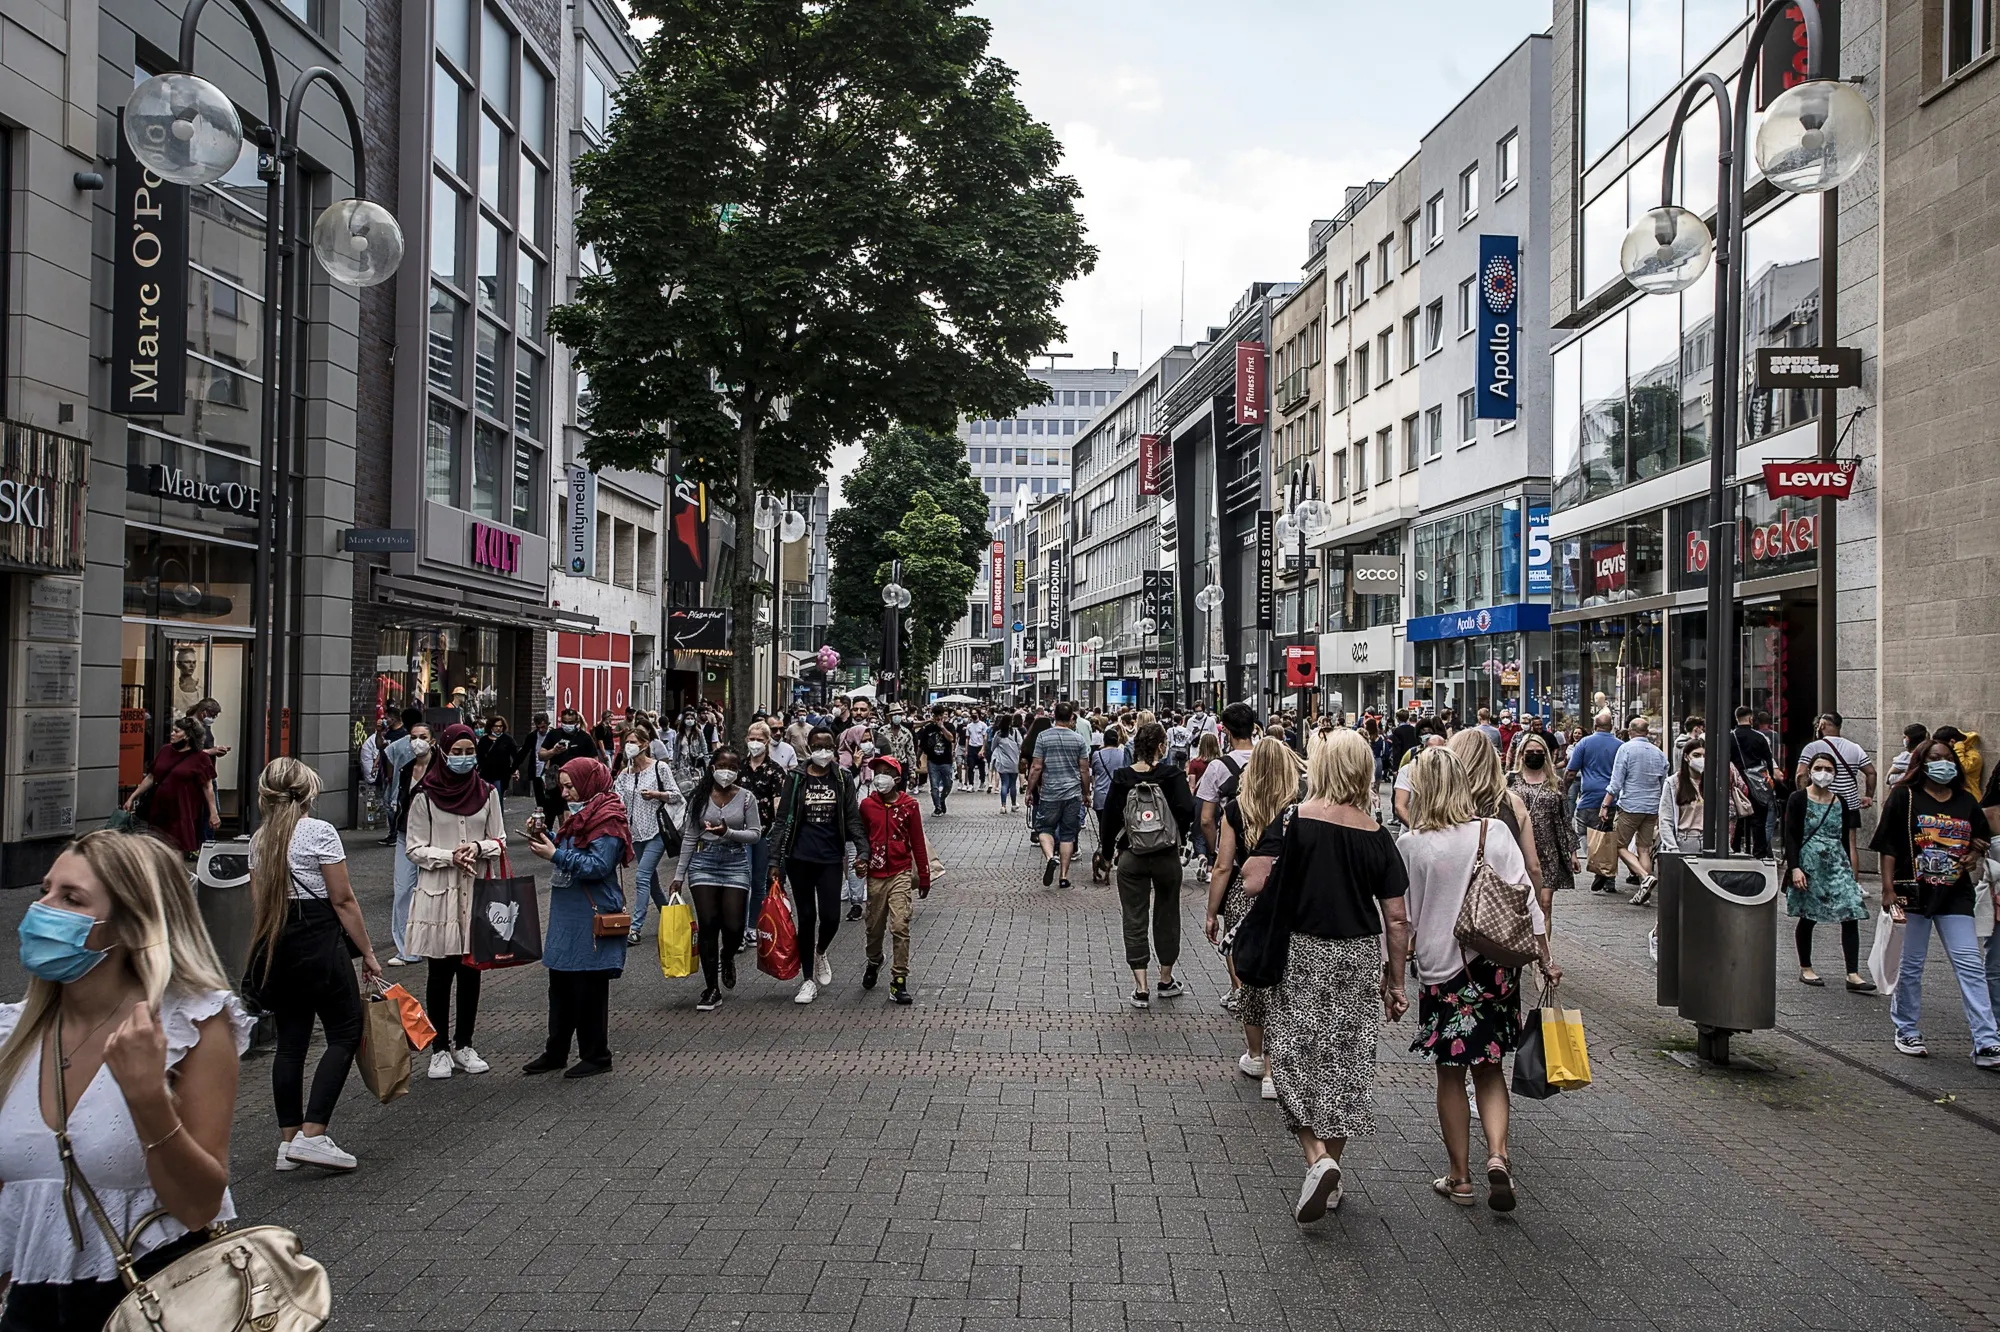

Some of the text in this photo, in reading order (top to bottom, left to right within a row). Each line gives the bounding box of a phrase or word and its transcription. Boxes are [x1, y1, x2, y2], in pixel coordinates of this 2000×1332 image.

[130, 282, 161, 403] Marc
[1489, 323, 1514, 398] Apollo
[1769, 355, 1809, 366] HOUSE
[1791, 364, 1840, 375] HOOPS
[159, 463, 220, 505] Marc
[571, 471, 588, 552] unitymedia
[348, 536, 410, 545] Marc O'Polo
[473, 522, 522, 574] KULT
[1686, 531, 1709, 573] Fo
[994, 557, 1003, 611] BURGER KING
[1260, 521, 1271, 620] intimissimi
[1356, 569, 1398, 581] ecco
[687, 610, 725, 620] Pizza Hut
[1050, 559, 1060, 629] CALZEDONIA
[1457, 615, 1475, 633] Apollo
[120, 710, 145, 721] EMBERS
